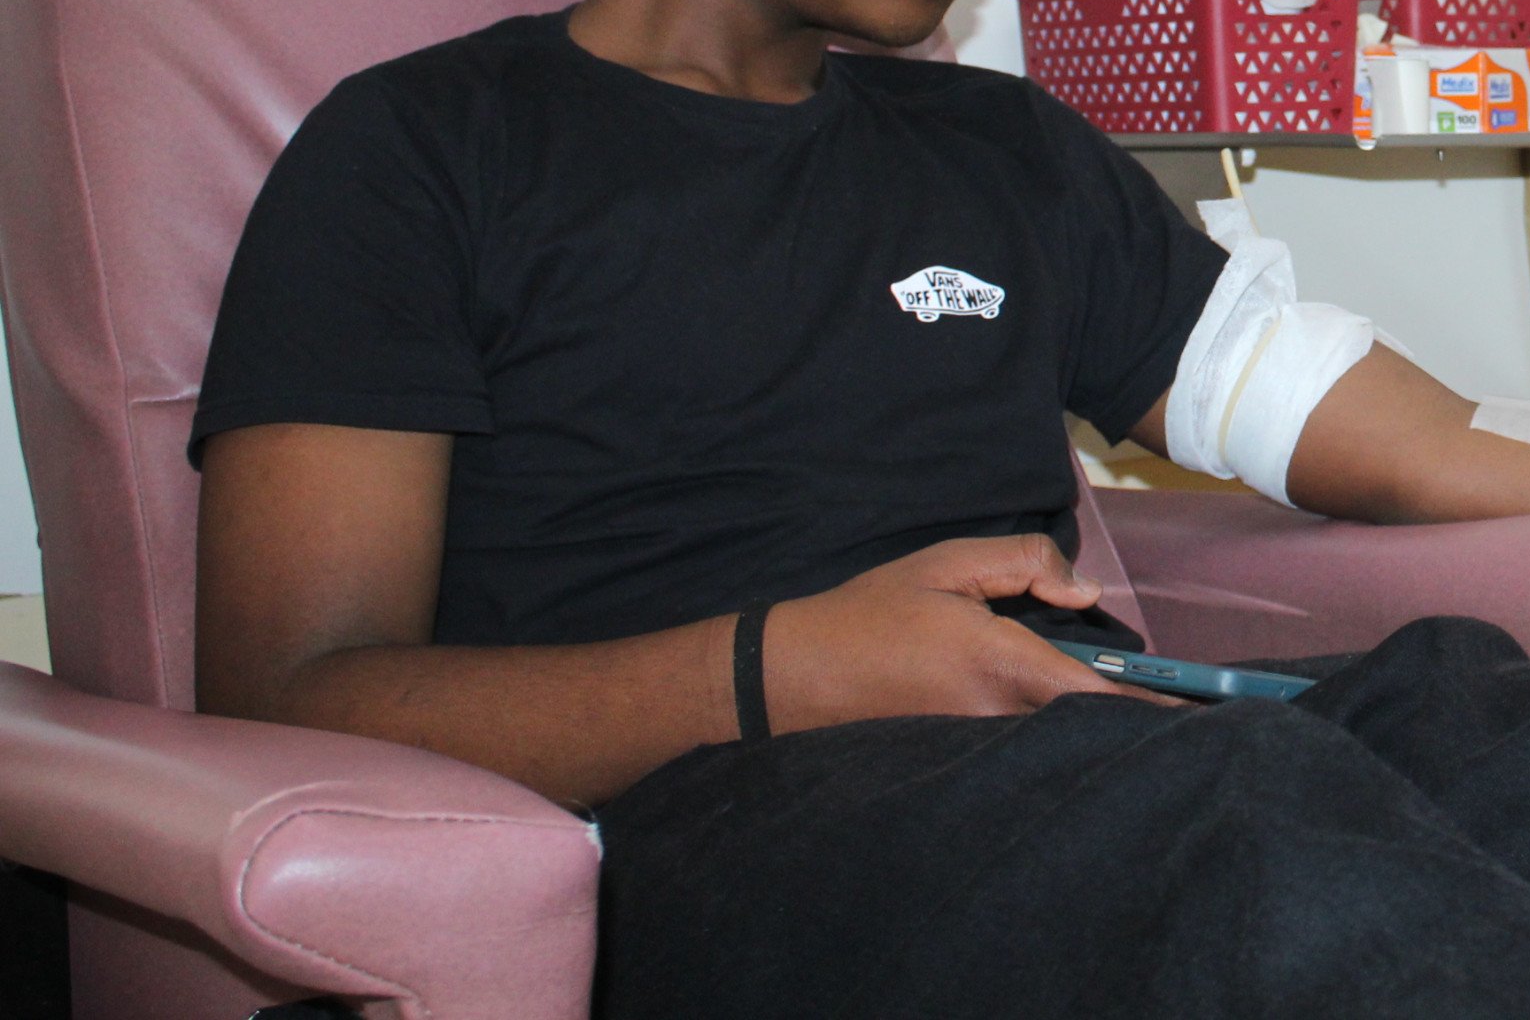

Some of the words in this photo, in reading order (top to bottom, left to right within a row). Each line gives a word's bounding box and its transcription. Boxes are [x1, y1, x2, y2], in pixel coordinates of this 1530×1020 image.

[1457, 115, 1477, 125] 100
[924, 272, 963, 289] VANS
[933, 288, 962, 310] THE
